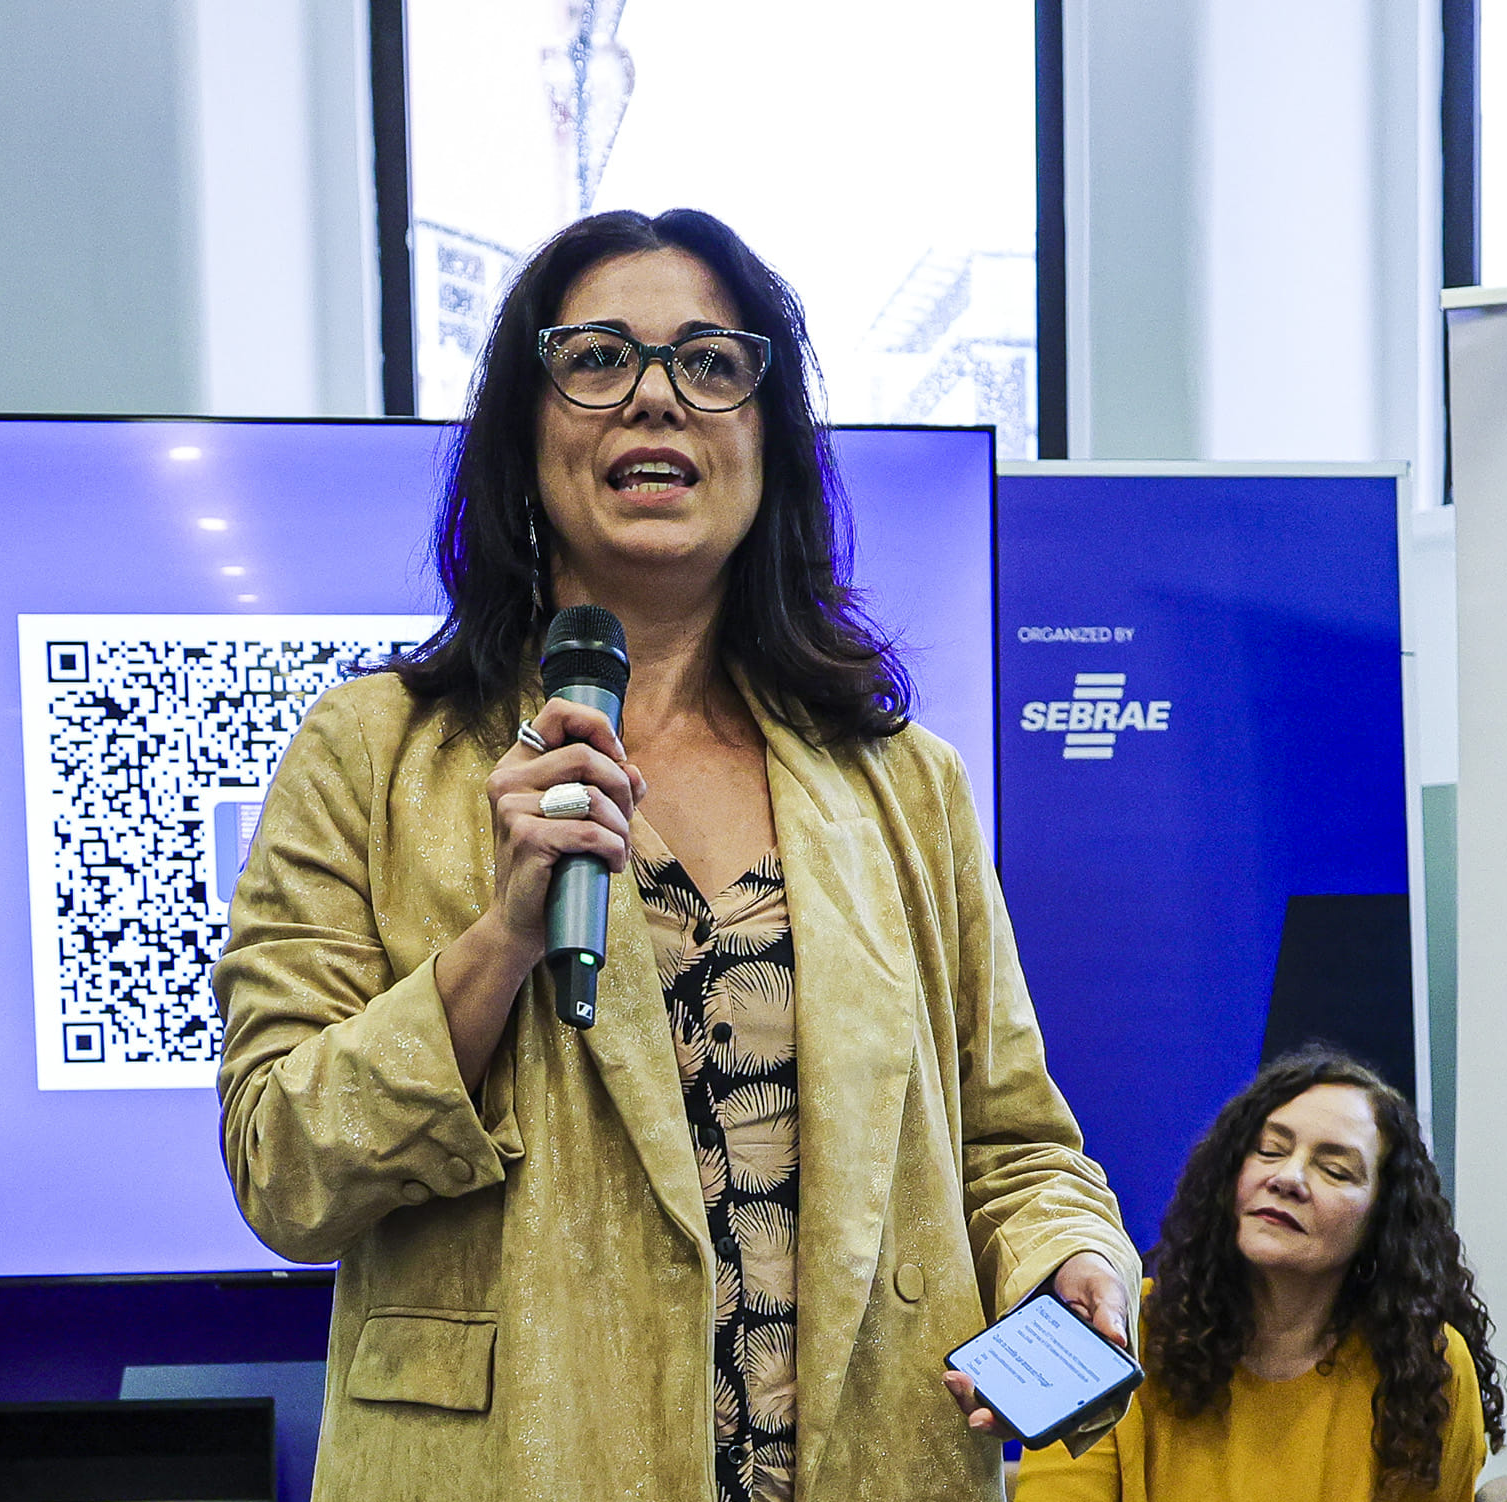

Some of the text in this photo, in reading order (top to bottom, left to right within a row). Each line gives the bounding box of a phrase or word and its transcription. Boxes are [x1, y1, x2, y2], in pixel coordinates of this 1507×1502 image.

[1017, 626, 1135, 643] ORGANIZED BY
[1020, 701, 1172, 731] SEBRAE
